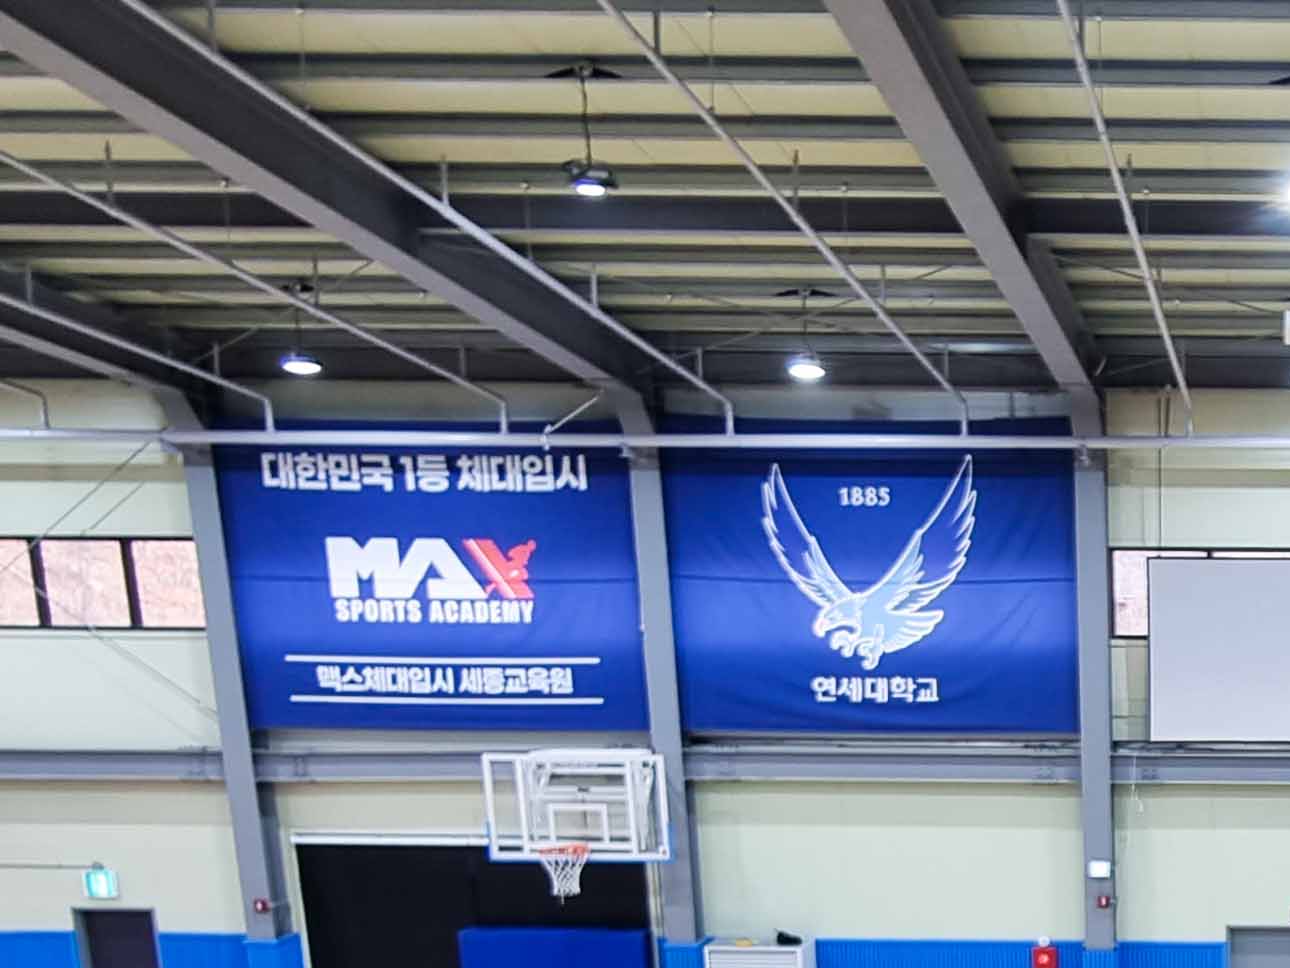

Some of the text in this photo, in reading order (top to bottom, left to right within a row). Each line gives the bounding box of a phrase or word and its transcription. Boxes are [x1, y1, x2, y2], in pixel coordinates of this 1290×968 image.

[261, 452, 588, 493] 대한민국 1등 체대입시
[839, 487, 890, 507] 1885
[325, 536, 536, 599] MAX
[335, 599, 534, 624] SPORTS ACADEMY
[316, 665, 574, 694] 맥스체대입시 세종교육원
[811, 676, 939, 703] 연세대학교
